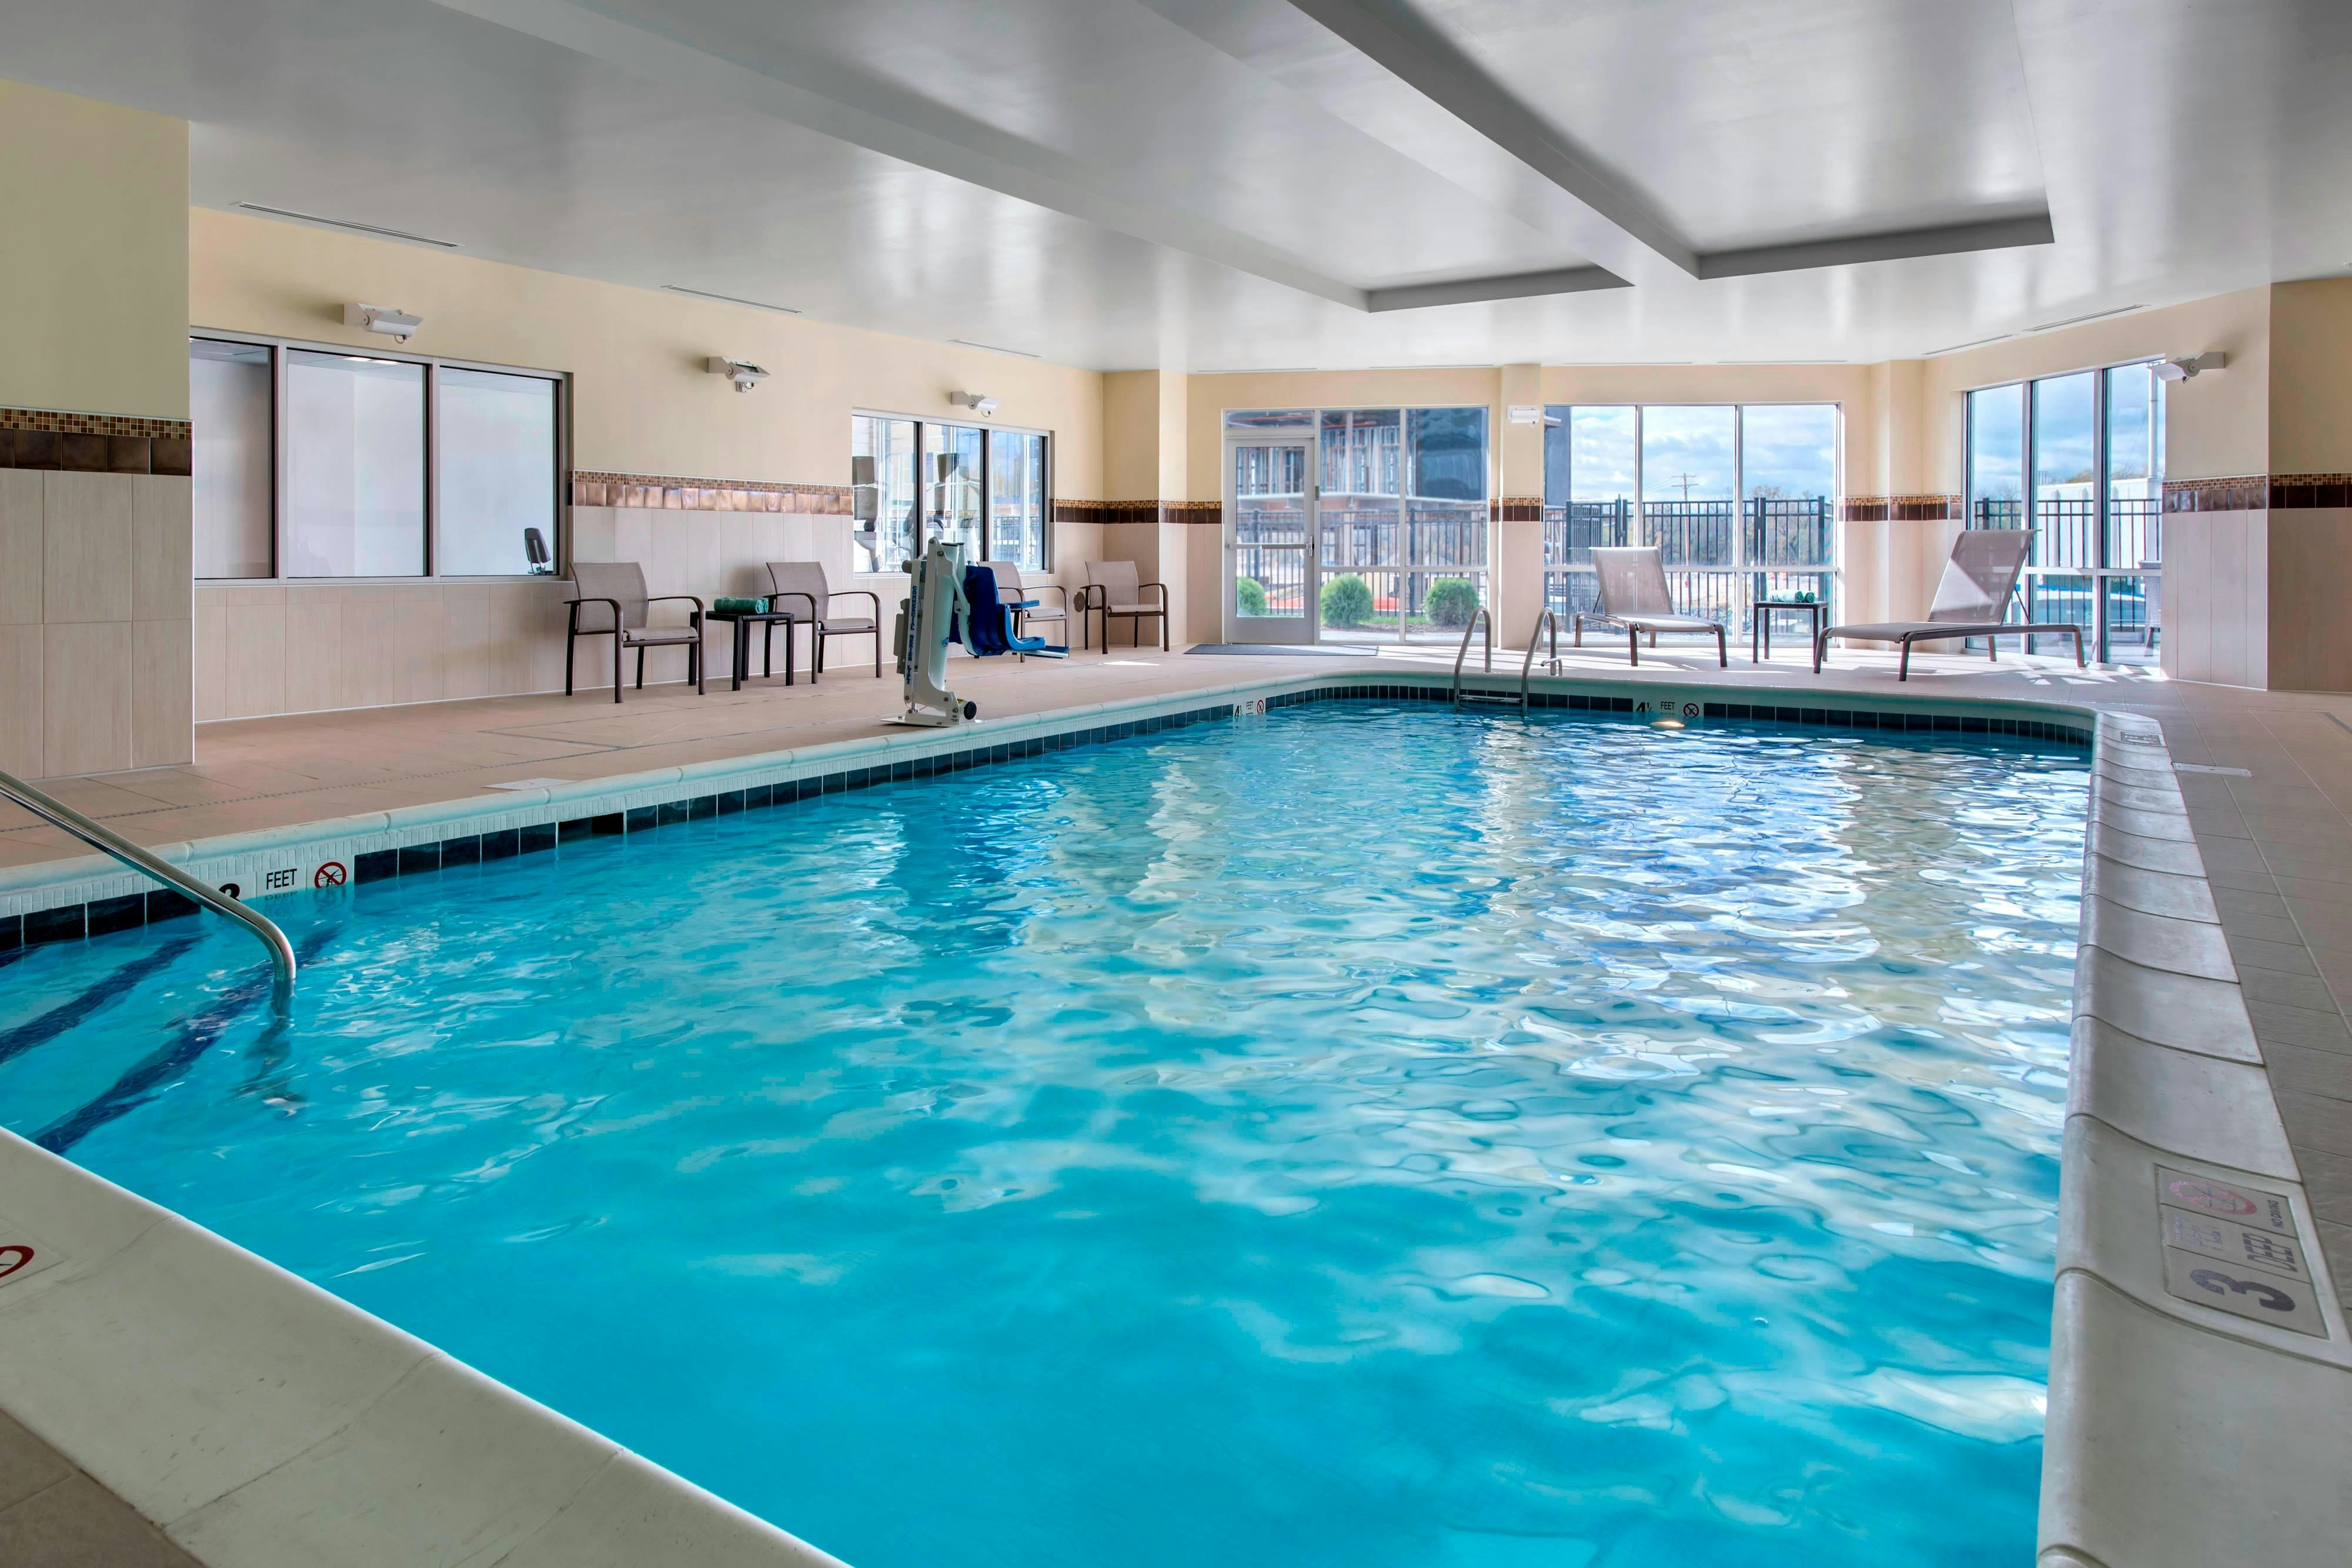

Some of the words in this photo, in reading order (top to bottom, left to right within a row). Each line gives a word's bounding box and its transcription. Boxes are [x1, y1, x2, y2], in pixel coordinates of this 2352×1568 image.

[1661, 701, 1675, 710] FEET
[266, 868, 298, 890] FEET
[2267, 1199, 2282, 1220] DIVING
[2271, 1218, 2284, 1229] NO
[2242, 1232, 2298, 1273] DEEP
[2190, 1269, 2296, 1312] 3
